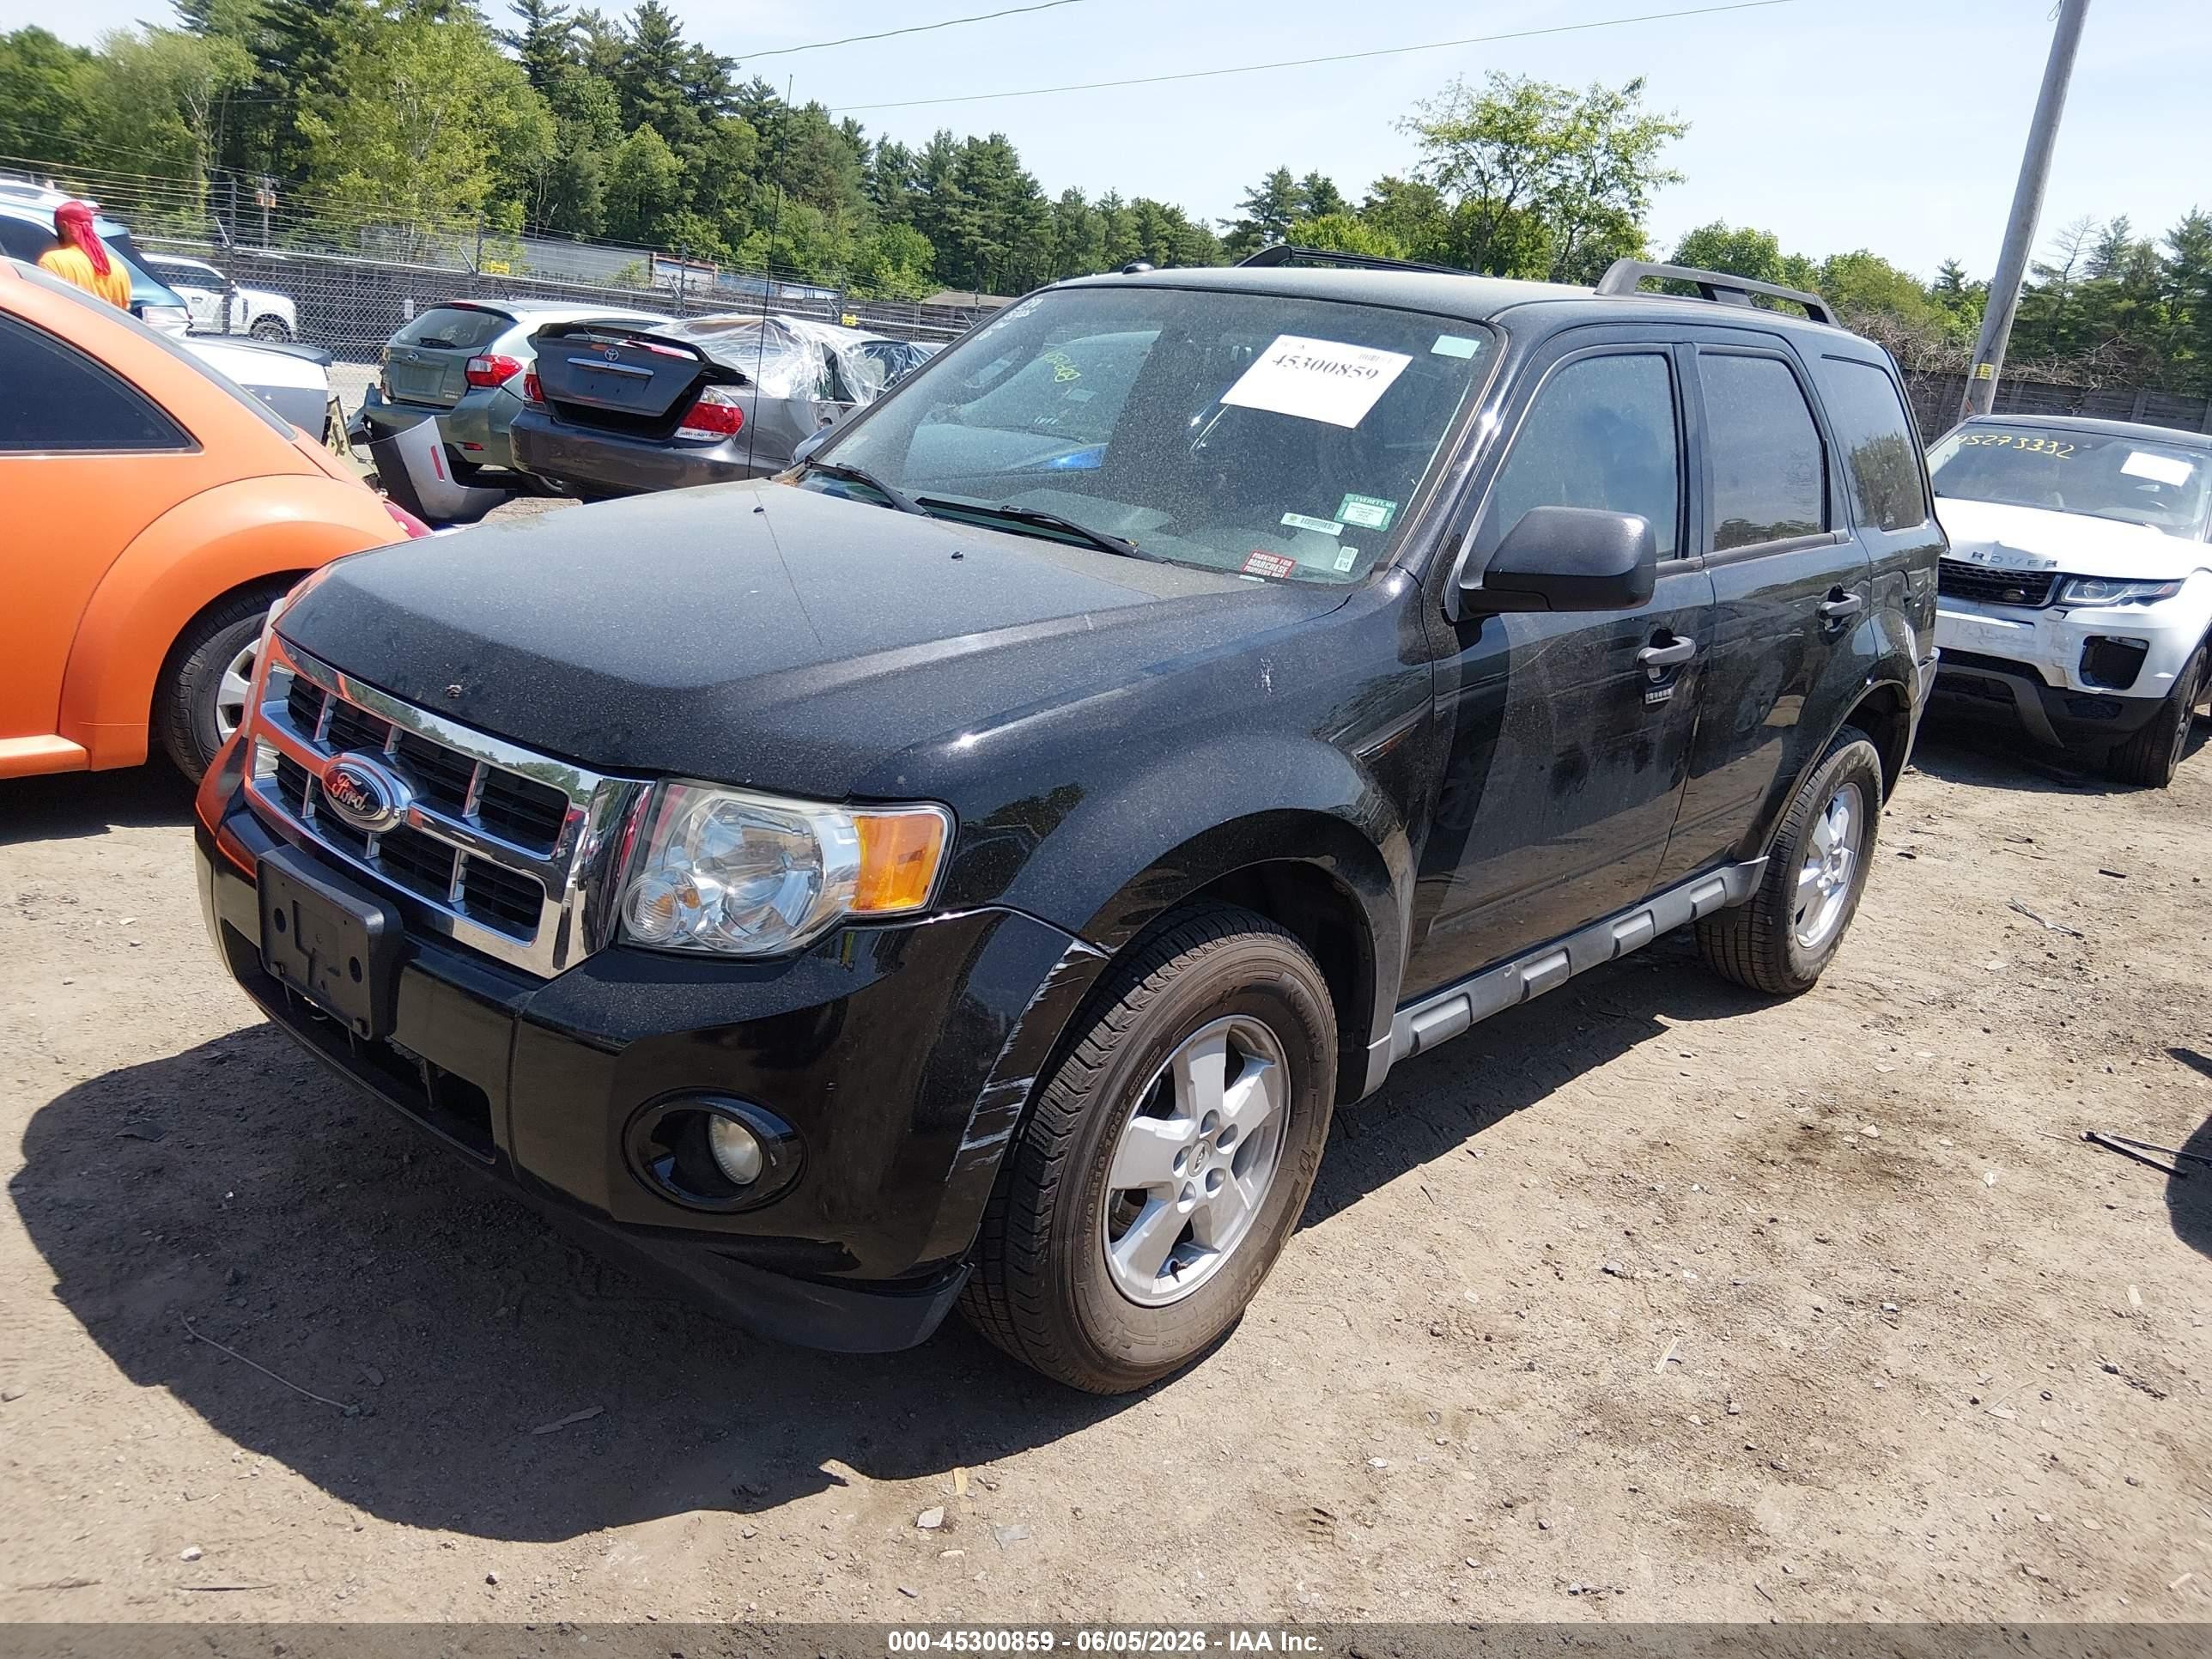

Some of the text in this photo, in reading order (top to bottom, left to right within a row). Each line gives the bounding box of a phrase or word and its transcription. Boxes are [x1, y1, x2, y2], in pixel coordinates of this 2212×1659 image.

[1272, 354, 1380, 380] 45300859
[1248, 558, 1290, 574] MARCHESE
[1252, 551, 1279, 564] PARKING
[331, 772, 371, 811] Ford
